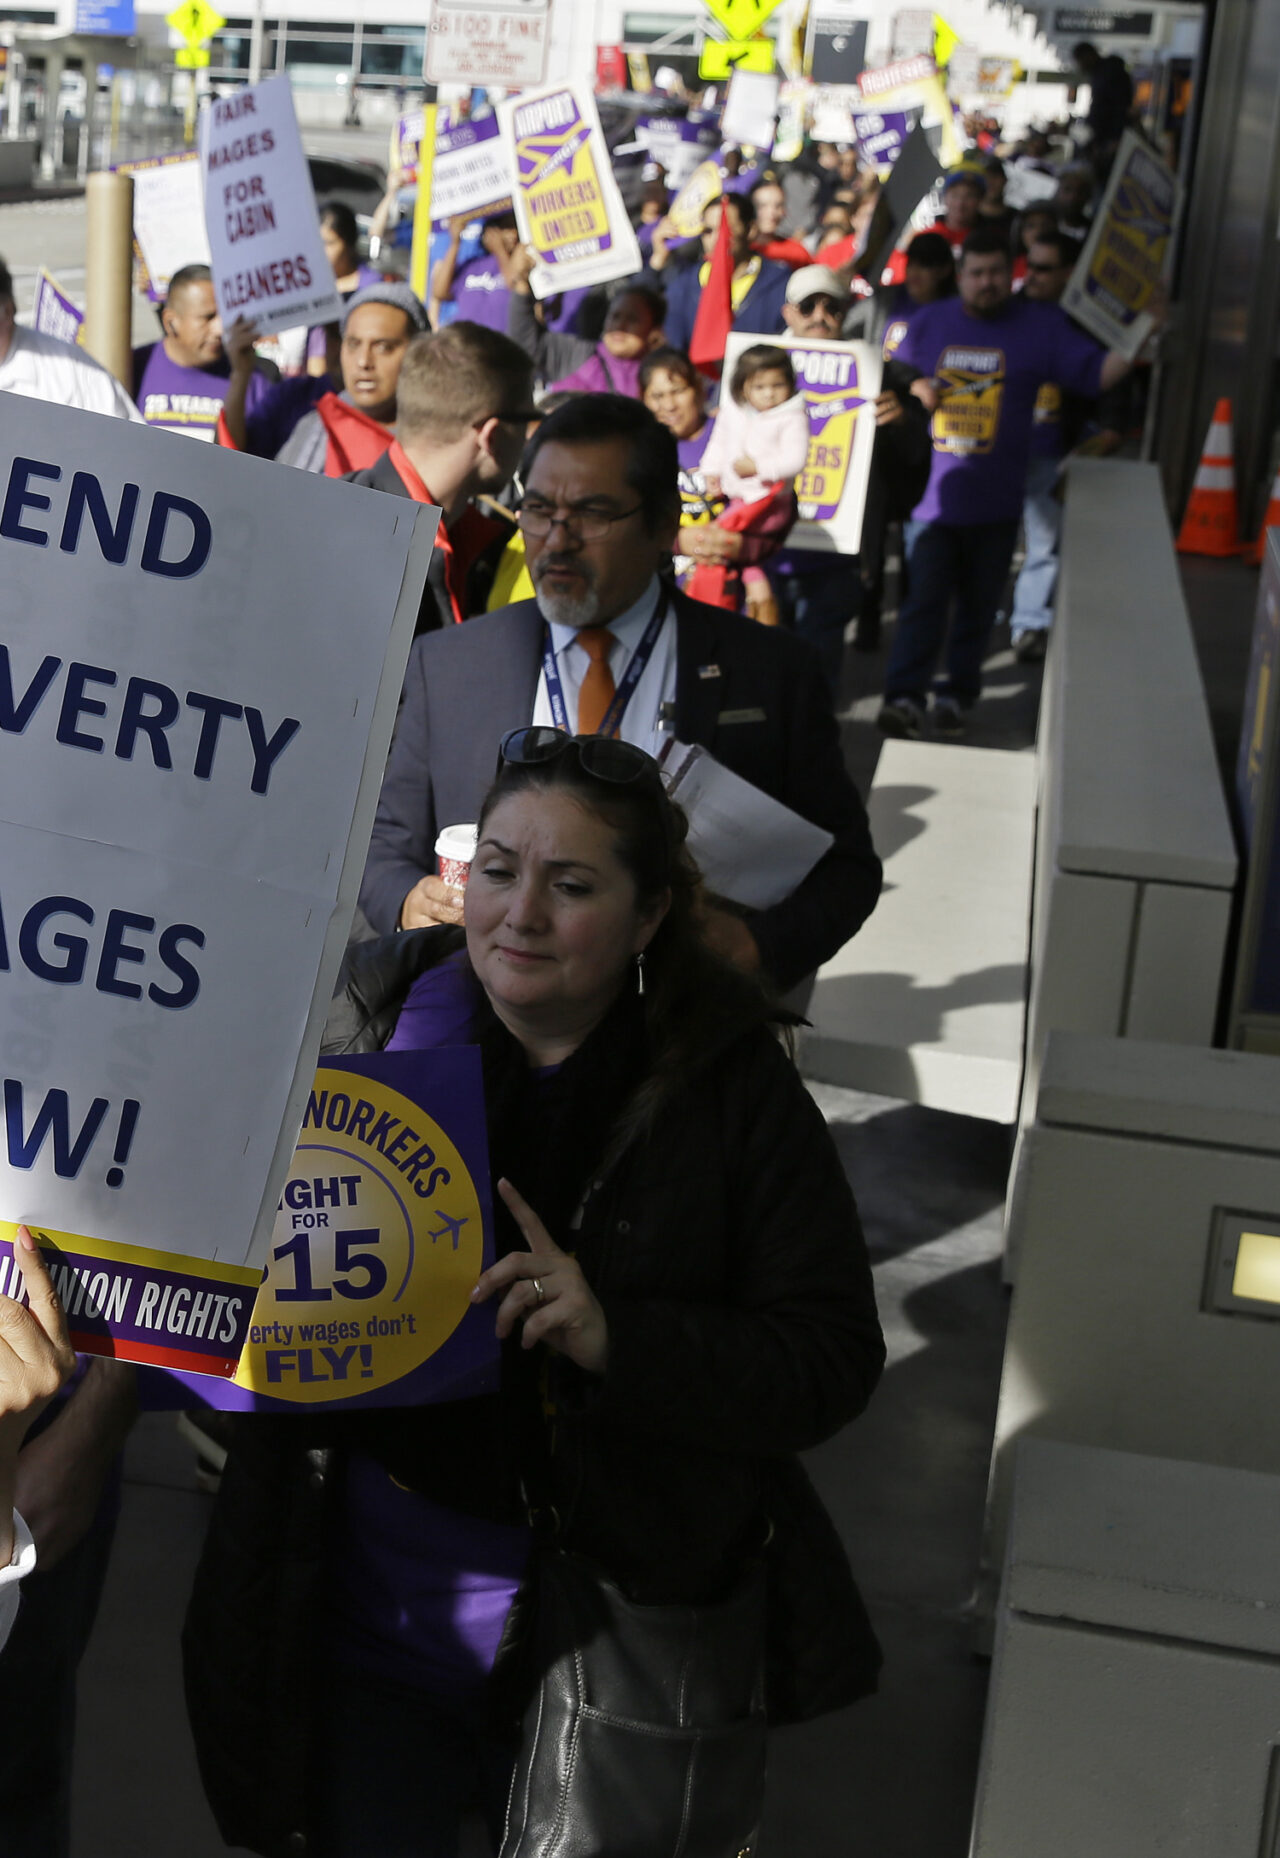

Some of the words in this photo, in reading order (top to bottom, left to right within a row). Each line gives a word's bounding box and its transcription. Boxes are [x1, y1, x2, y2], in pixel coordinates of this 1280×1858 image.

[213, 93, 257, 128] FAIR
[207, 128, 276, 171] WAGES
[223, 174, 266, 205] FOR
[225, 202, 277, 244] CABIN
[222, 253, 313, 311] CLEANERS
[790, 350, 855, 387] PORT
[0, 456, 214, 580] END
[278, 1175, 362, 1210] GHT
[291, 1213, 330, 1230] FOR
[261, 1228, 388, 1302] 15
[134, 1281, 242, 1344] RIGHTS
[247, 1321, 294, 1345] erty
[299, 1319, 360, 1345] wages
[366, 1313, 417, 1338] don't
[265, 1344, 374, 1384] FLY!
